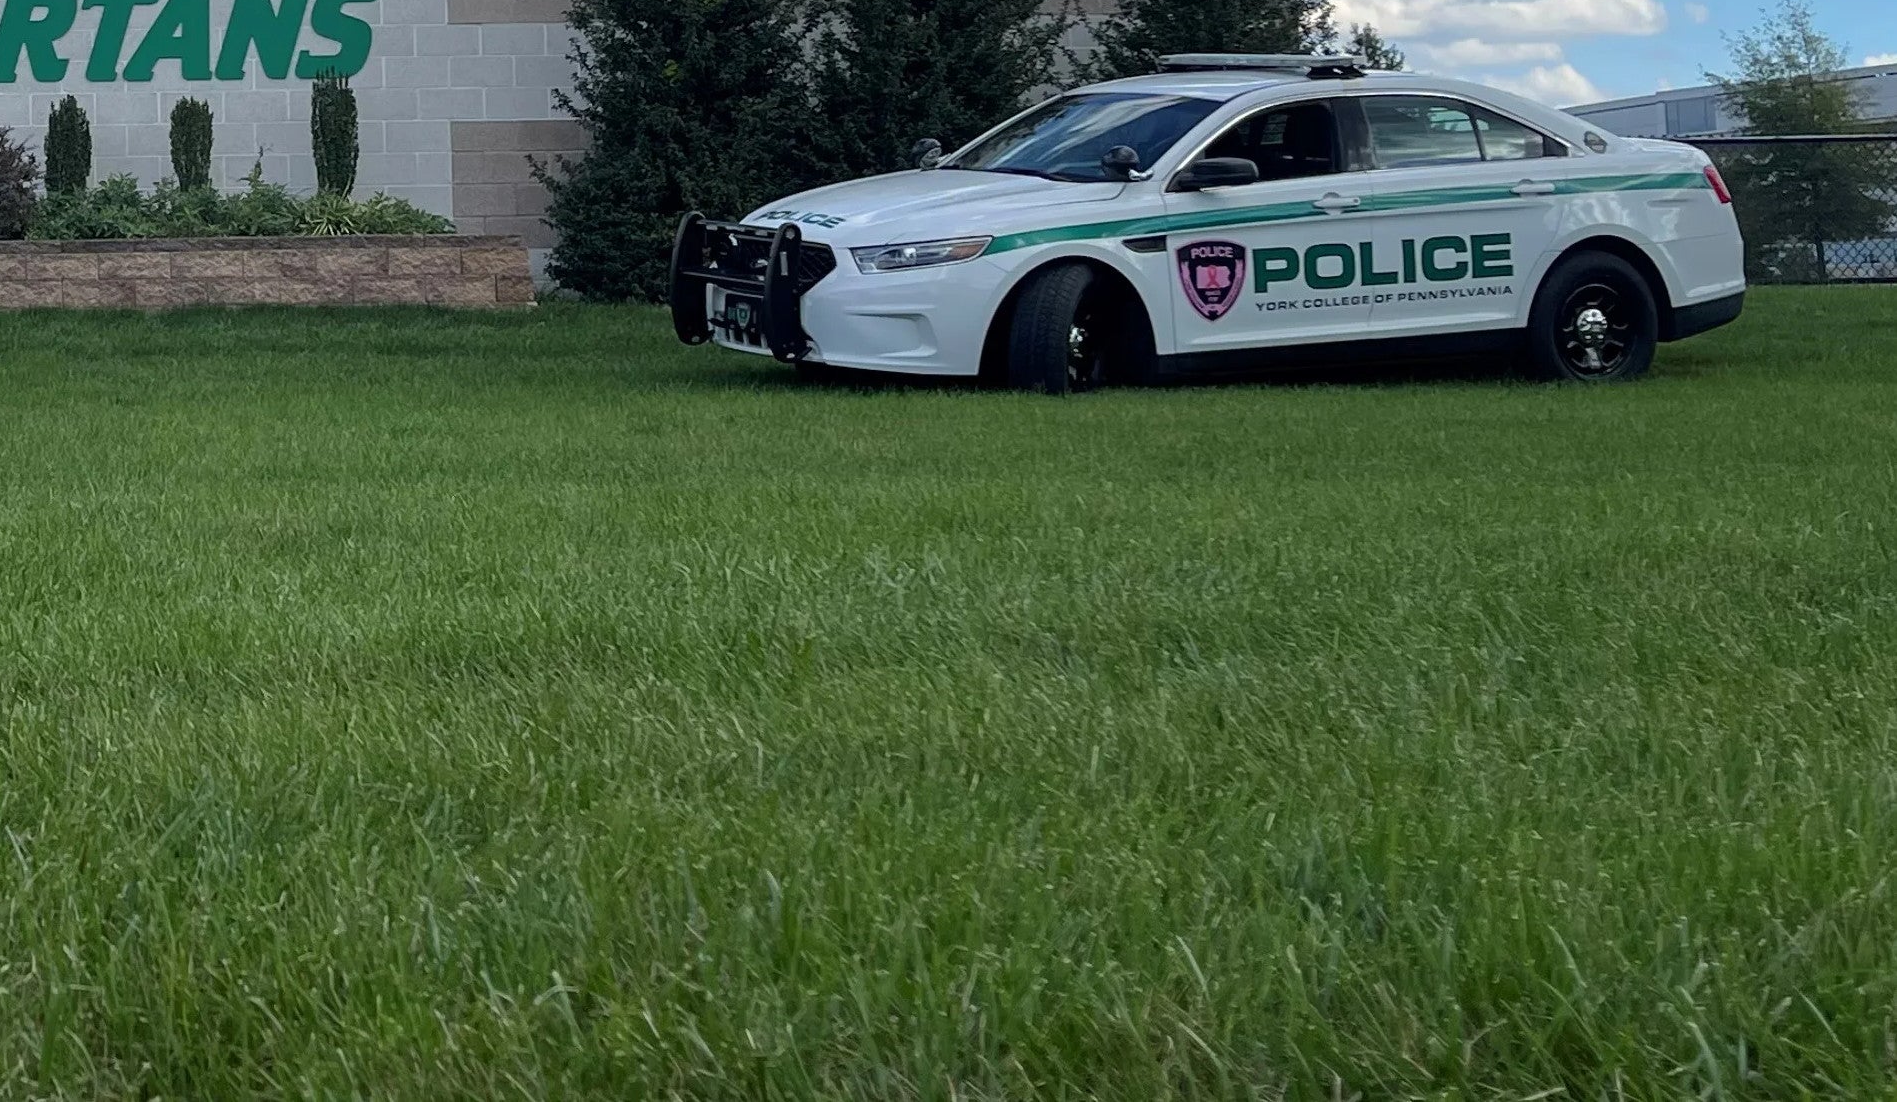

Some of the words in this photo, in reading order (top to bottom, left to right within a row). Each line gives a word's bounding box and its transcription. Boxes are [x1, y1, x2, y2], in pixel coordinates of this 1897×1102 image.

[1190, 246, 1234, 259] POLICE
[1252, 232, 1514, 294] POLICE
[1255, 299, 1298, 312] YORK
[1302, 295, 1370, 309] COLLEGE
[1374, 293, 1394, 304] OF
[1397, 285, 1514, 302] PENNSYLVANIA
